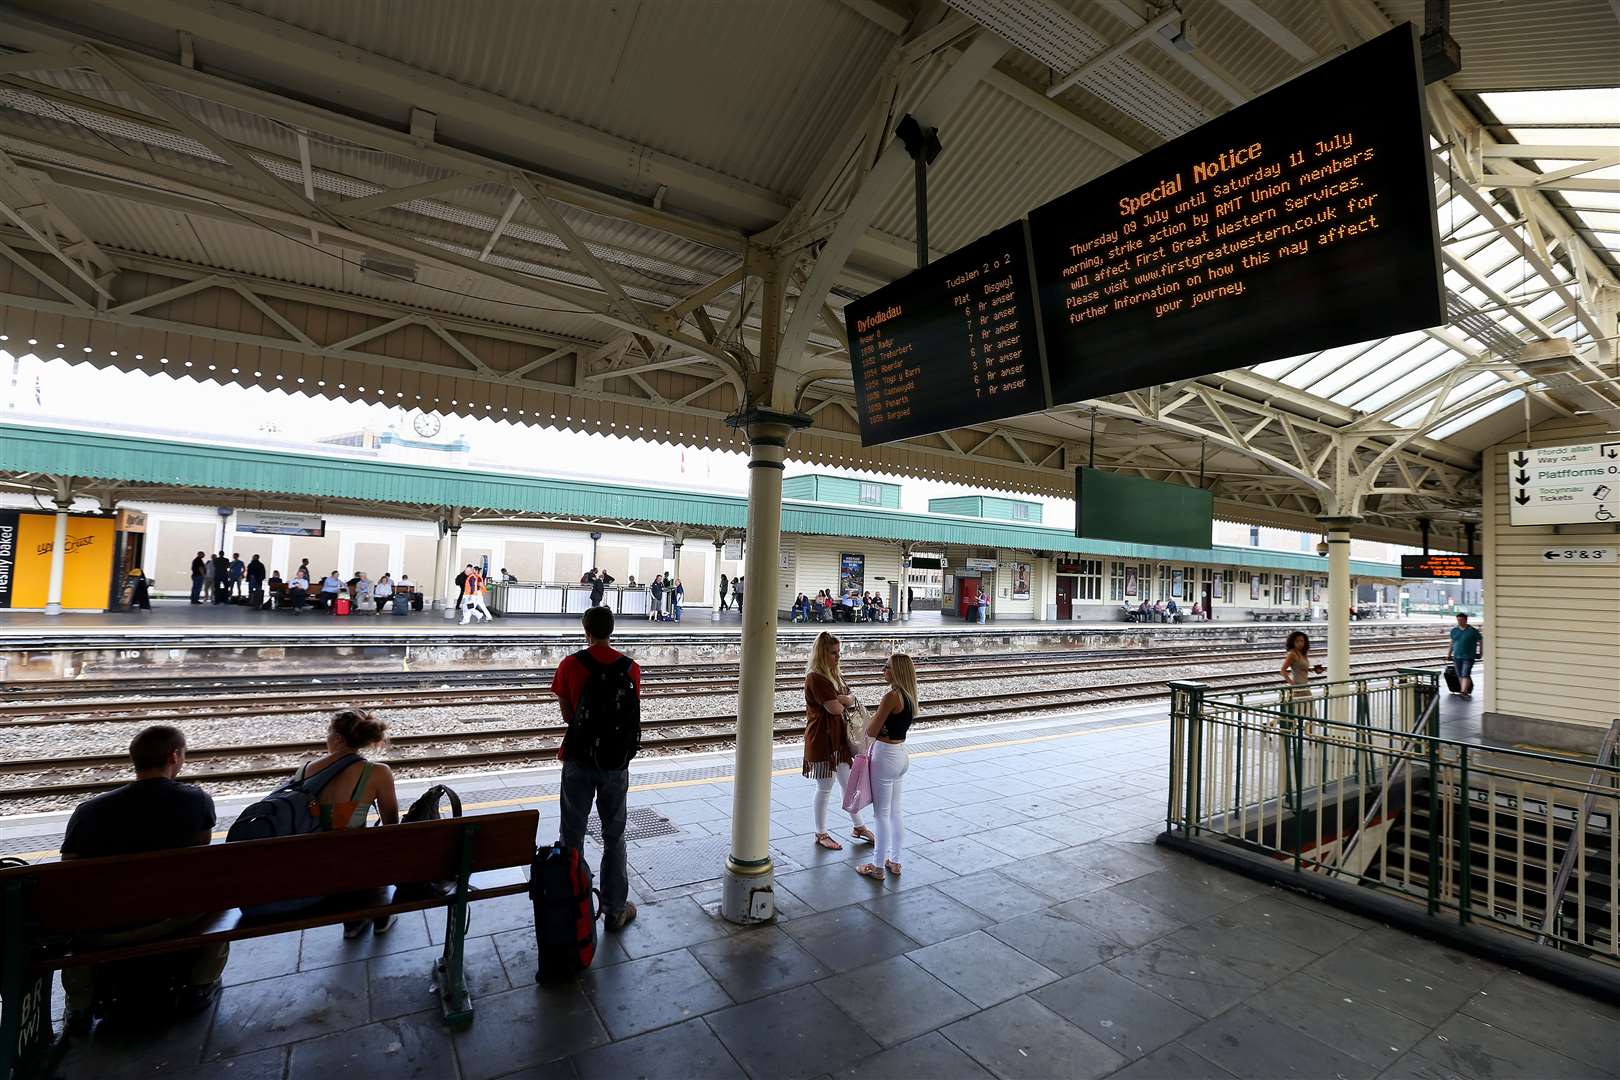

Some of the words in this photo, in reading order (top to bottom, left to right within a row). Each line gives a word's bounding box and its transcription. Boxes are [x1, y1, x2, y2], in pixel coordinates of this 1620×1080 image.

[1062, 255, 1104, 277] morning,
[1108, 239, 1143, 259] strike
[1148, 222, 1187, 244] action
[1192, 212, 1209, 227] by
[1215, 195, 1243, 218] RMT
[1251, 181, 1291, 204] Union
[1299, 147, 1374, 186] members
[1069, 230, 1119, 257] Thursday
[1123, 220, 1137, 235] 09
[1143, 209, 1169, 228] July
[1175, 191, 1207, 214] until
[1213, 162, 1281, 198] Saturday
[1289, 150, 1305, 168] 11
[1314, 133, 1353, 157] July
[1119, 173, 1182, 216] Special
[1192, 142, 1263, 185] Notice
[945, 269, 980, 288] Tudalen
[983, 263, 990, 274] 2
[1004, 253, 1011, 265] 2
[1066, 291, 1100, 309] Please
[1103, 278, 1129, 296] visit
[1347, 193, 1378, 213] for
[1069, 304, 1109, 324] further
[1113, 281, 1180, 310] information
[1186, 274, 1202, 287] on
[1207, 263, 1234, 280] how
[1241, 251, 1271, 269] this
[1278, 239, 1309, 258] may
[1318, 214, 1379, 245] affect
[1070, 274, 1089, 290] will
[1094, 259, 1131, 282] affect
[1135, 246, 1166, 267] First
[1171, 230, 1210, 254] Great
[1216, 208, 1277, 238] Western
[1284, 176, 1364, 212] Services.
[954, 293, 971, 306] Plat
[1155, 299, 1183, 318] your
[1191, 281, 1246, 308] journey.
[1538, 468, 1605, 481] Platfforms
